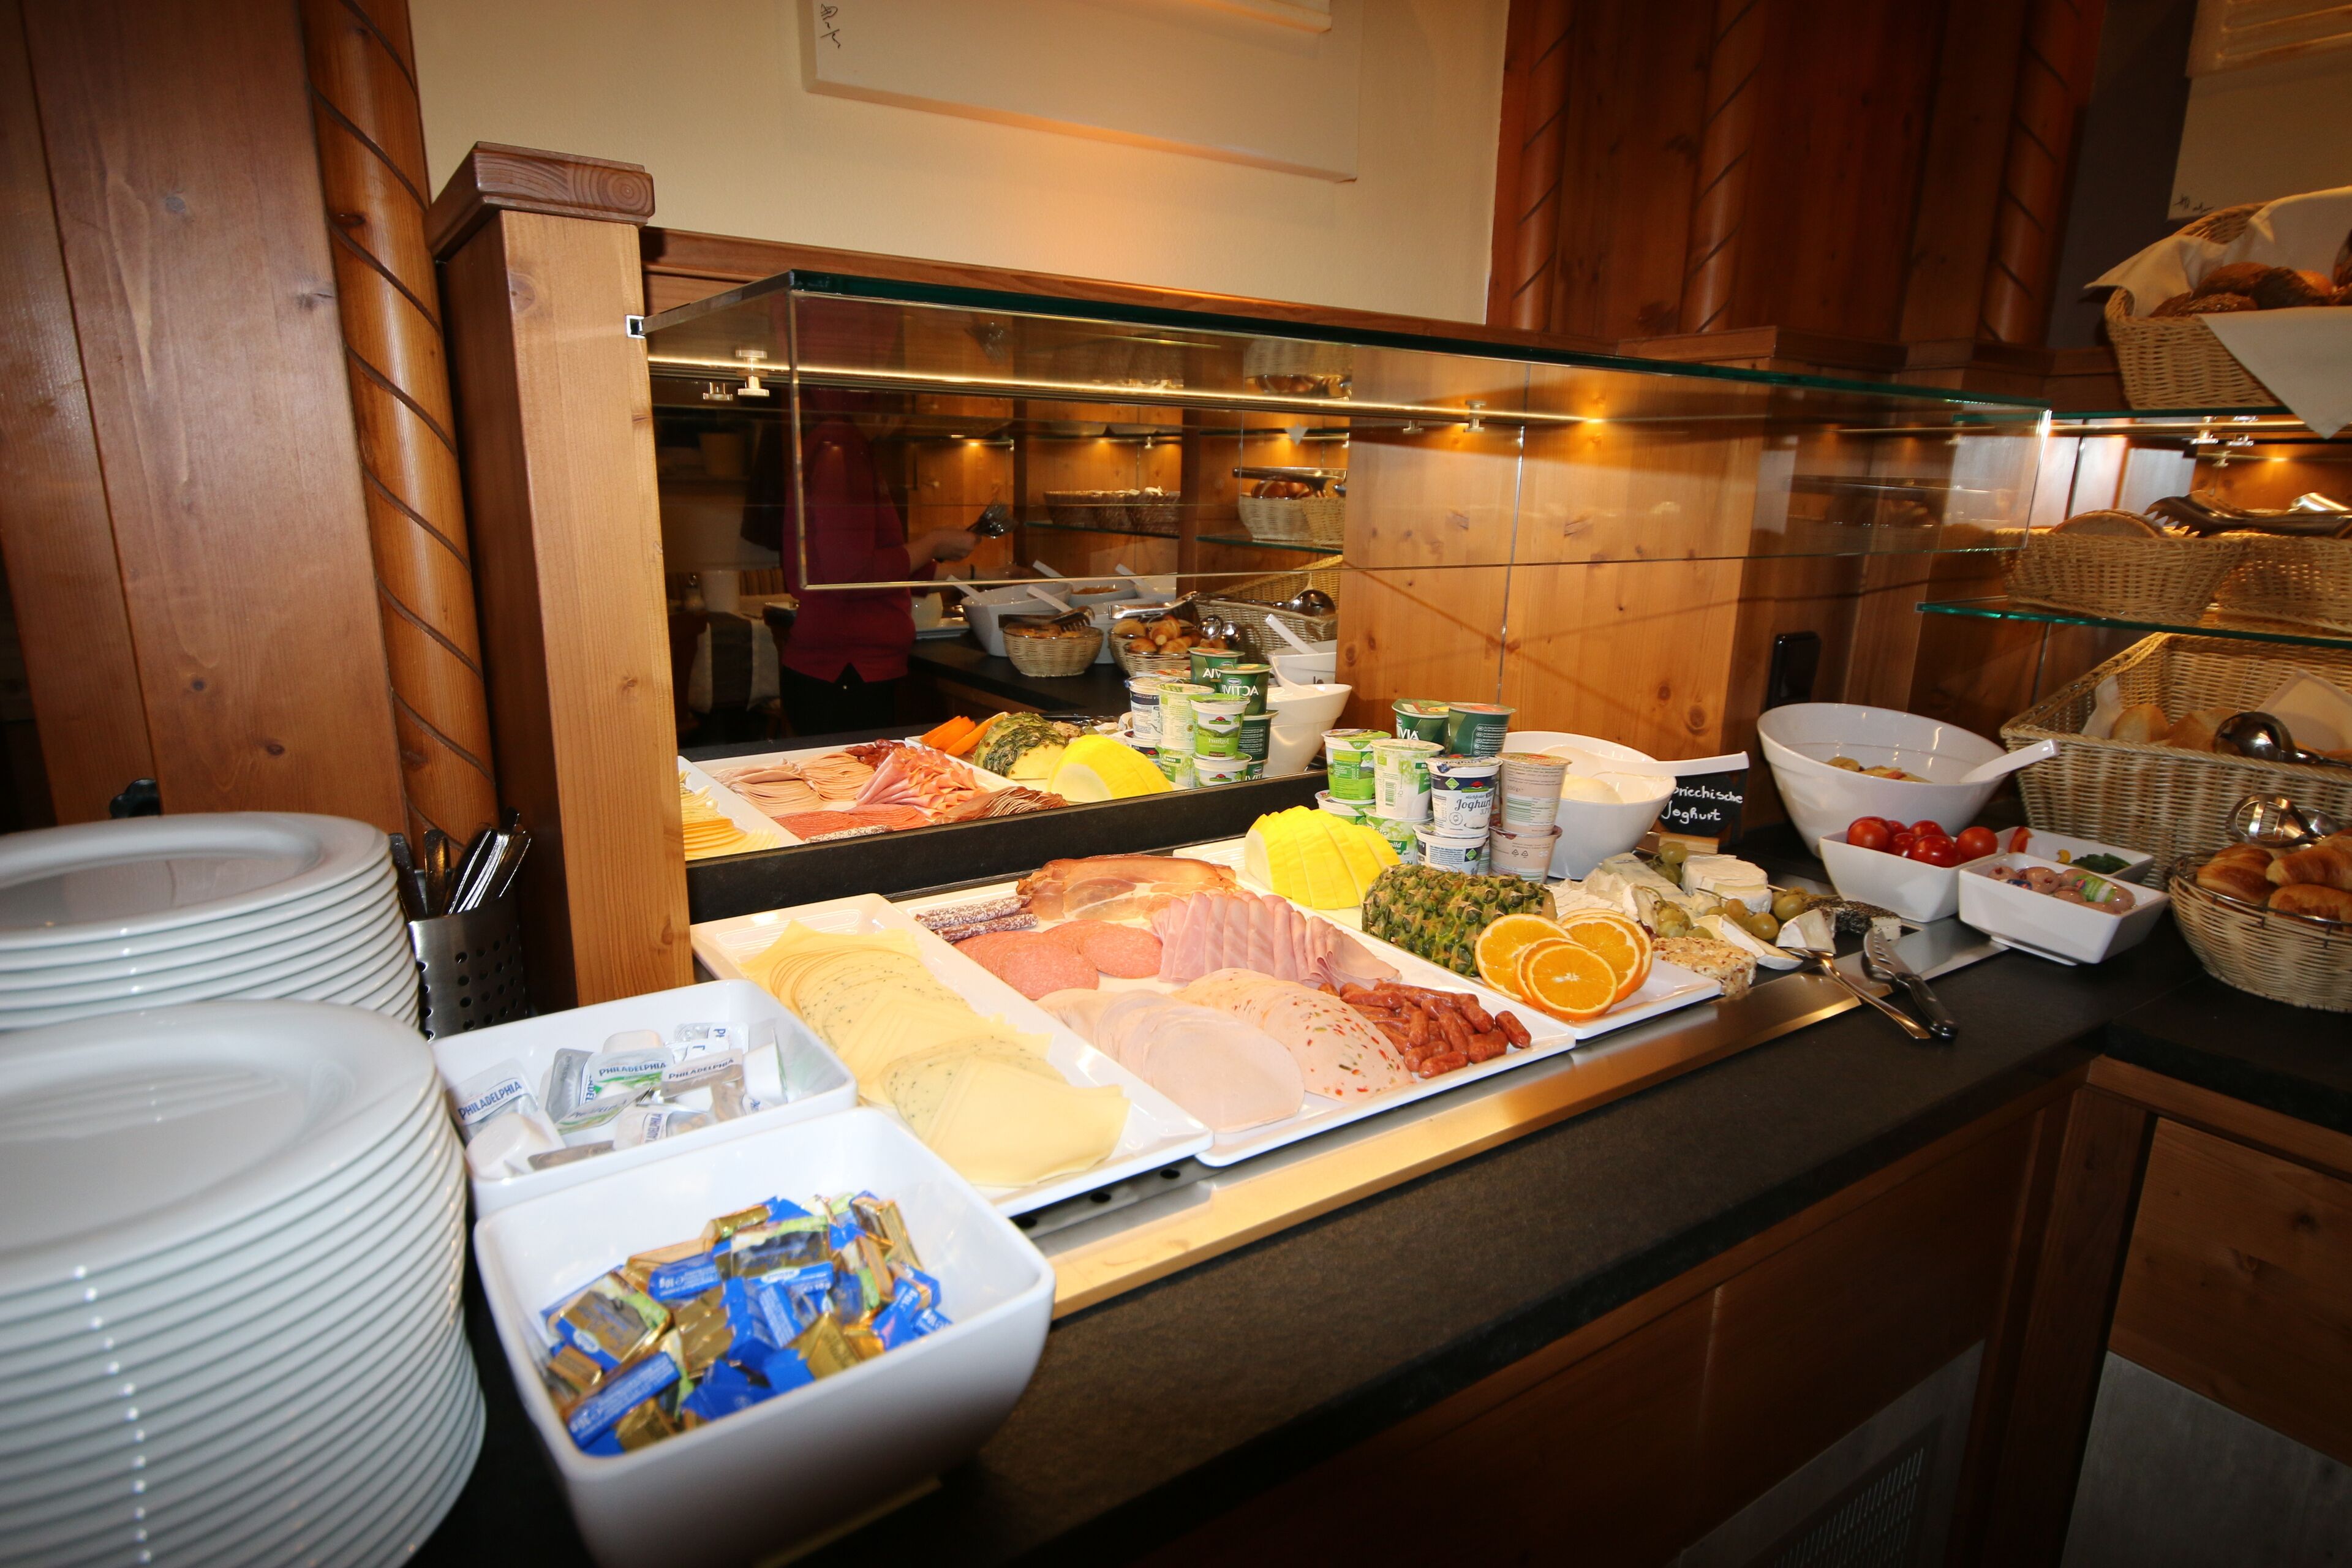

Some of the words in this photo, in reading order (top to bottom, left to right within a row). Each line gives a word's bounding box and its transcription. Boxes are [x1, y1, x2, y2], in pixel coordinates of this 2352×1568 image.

[1396, 725, 1420, 740] IVIA
[1455, 798, 1491, 812] Joghurt
[1661, 800, 1721, 824] Joghurt
[599, 1062, 667, 1076] PHILADELPHIA
[668, 1058, 734, 1080] PHILADELPHIA
[458, 1081, 522, 1120] PHILADELPHIA
